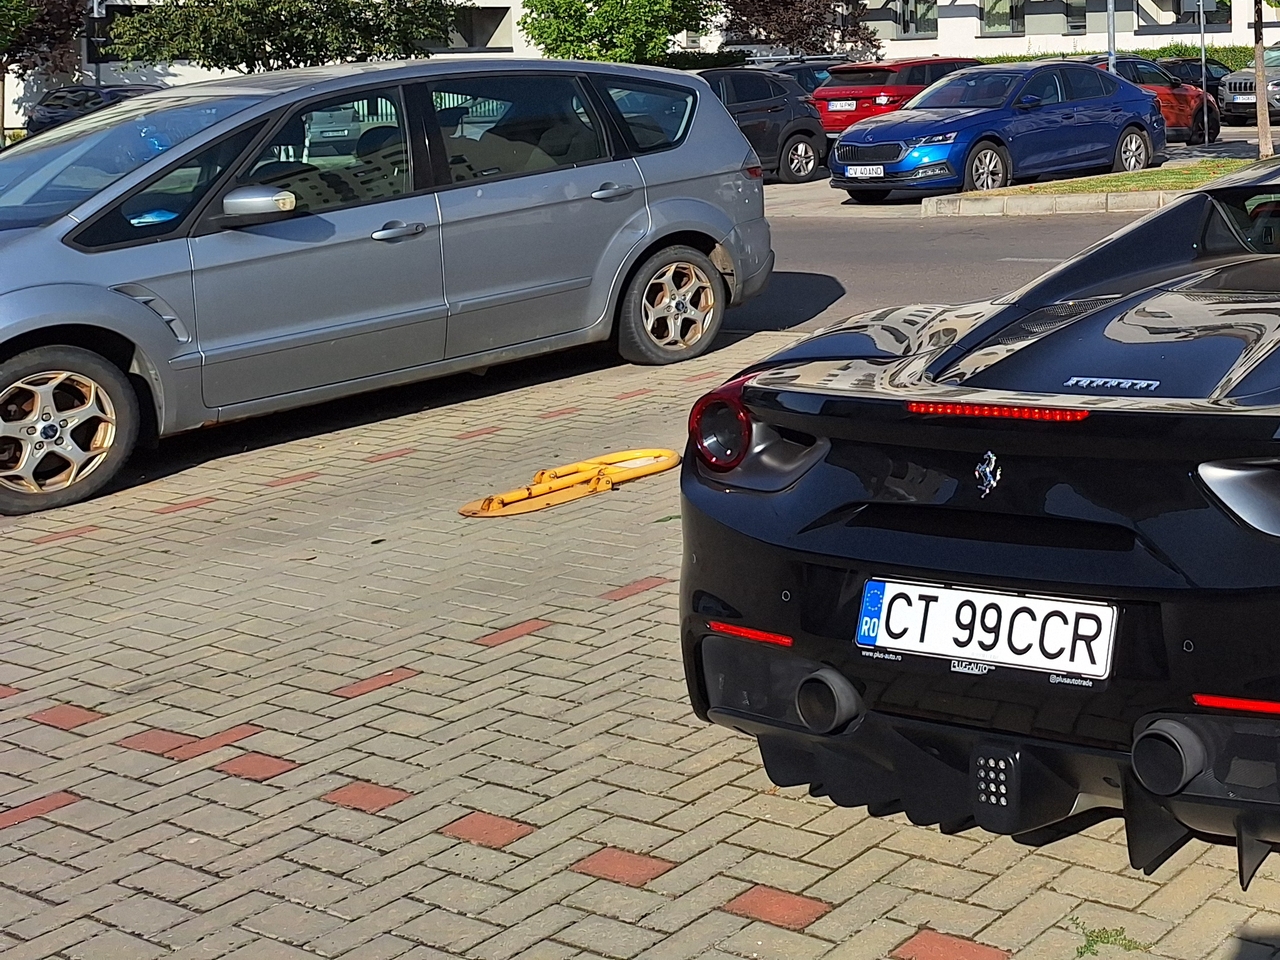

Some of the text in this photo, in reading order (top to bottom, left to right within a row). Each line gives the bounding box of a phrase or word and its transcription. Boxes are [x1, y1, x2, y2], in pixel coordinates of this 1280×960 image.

[861, 616, 879, 637] RO
[885, 592, 1102, 665] CT 99CCR
